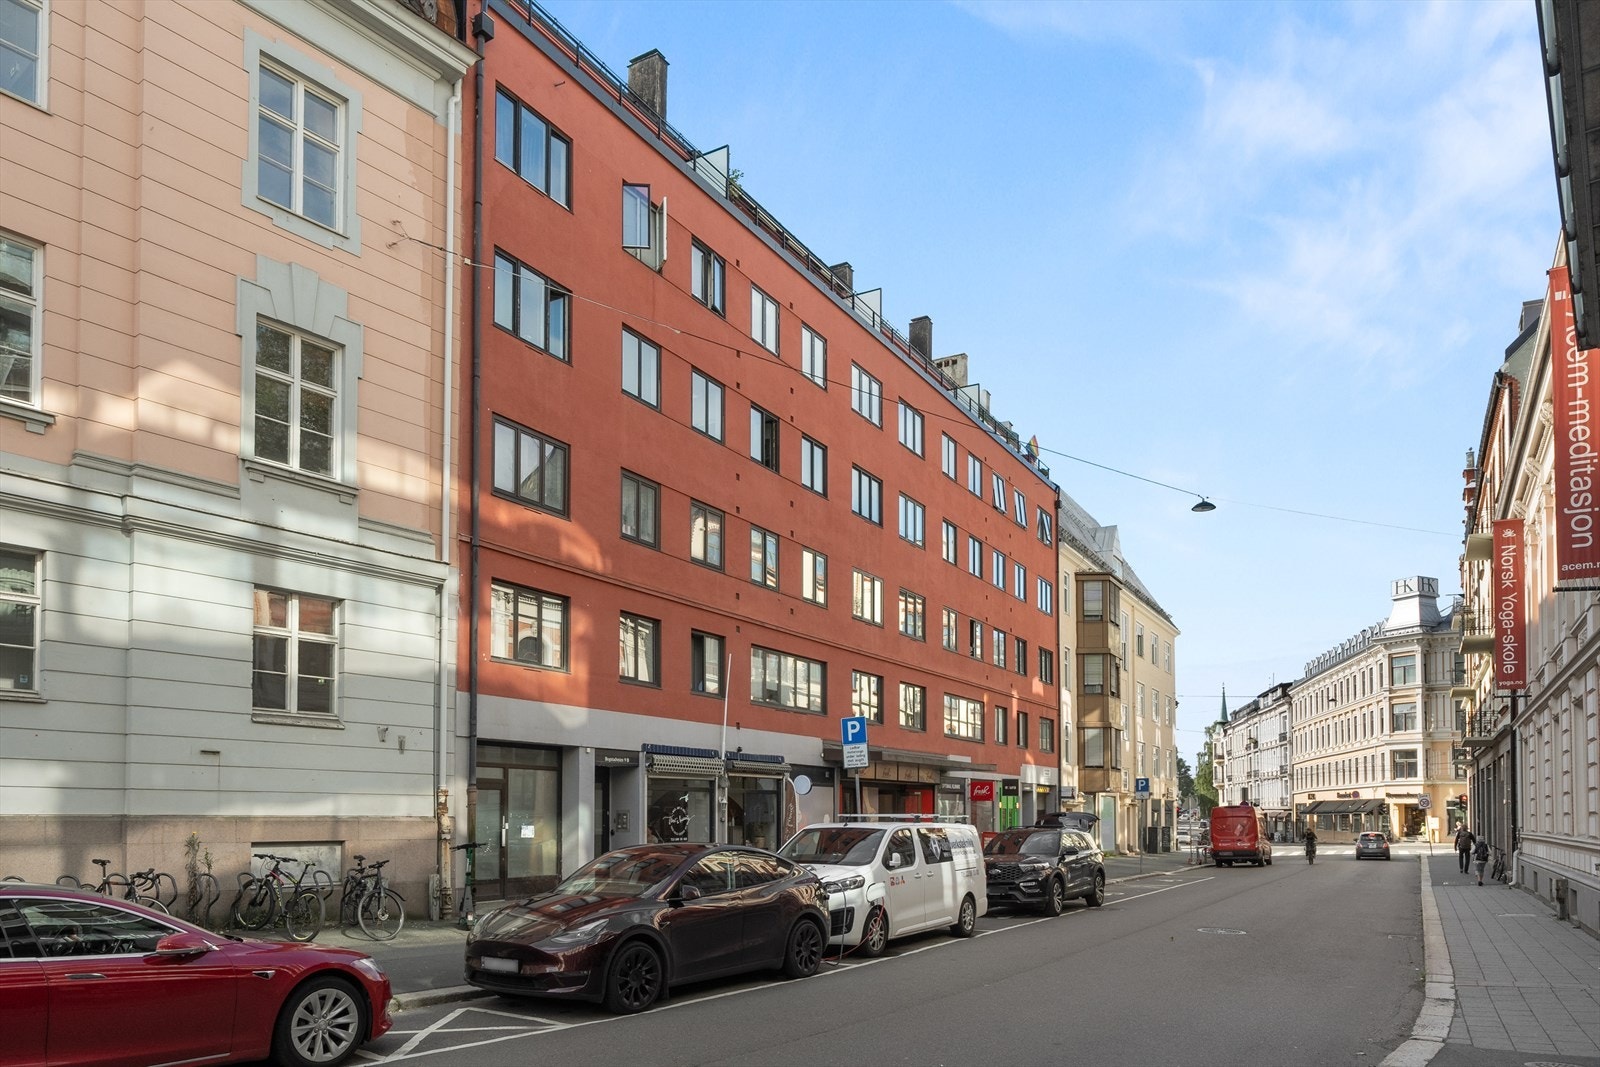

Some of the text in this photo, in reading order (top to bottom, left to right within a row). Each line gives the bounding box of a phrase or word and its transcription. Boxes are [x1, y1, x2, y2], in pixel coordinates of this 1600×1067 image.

[1395, 579, 1413, 594] HK
[1421, 578, 1435, 592] HK
[1498, 544, 1519, 674] Norsk Yoga-skole
[847, 721, 860, 741] P
[1138, 779, 1146, 791] P
